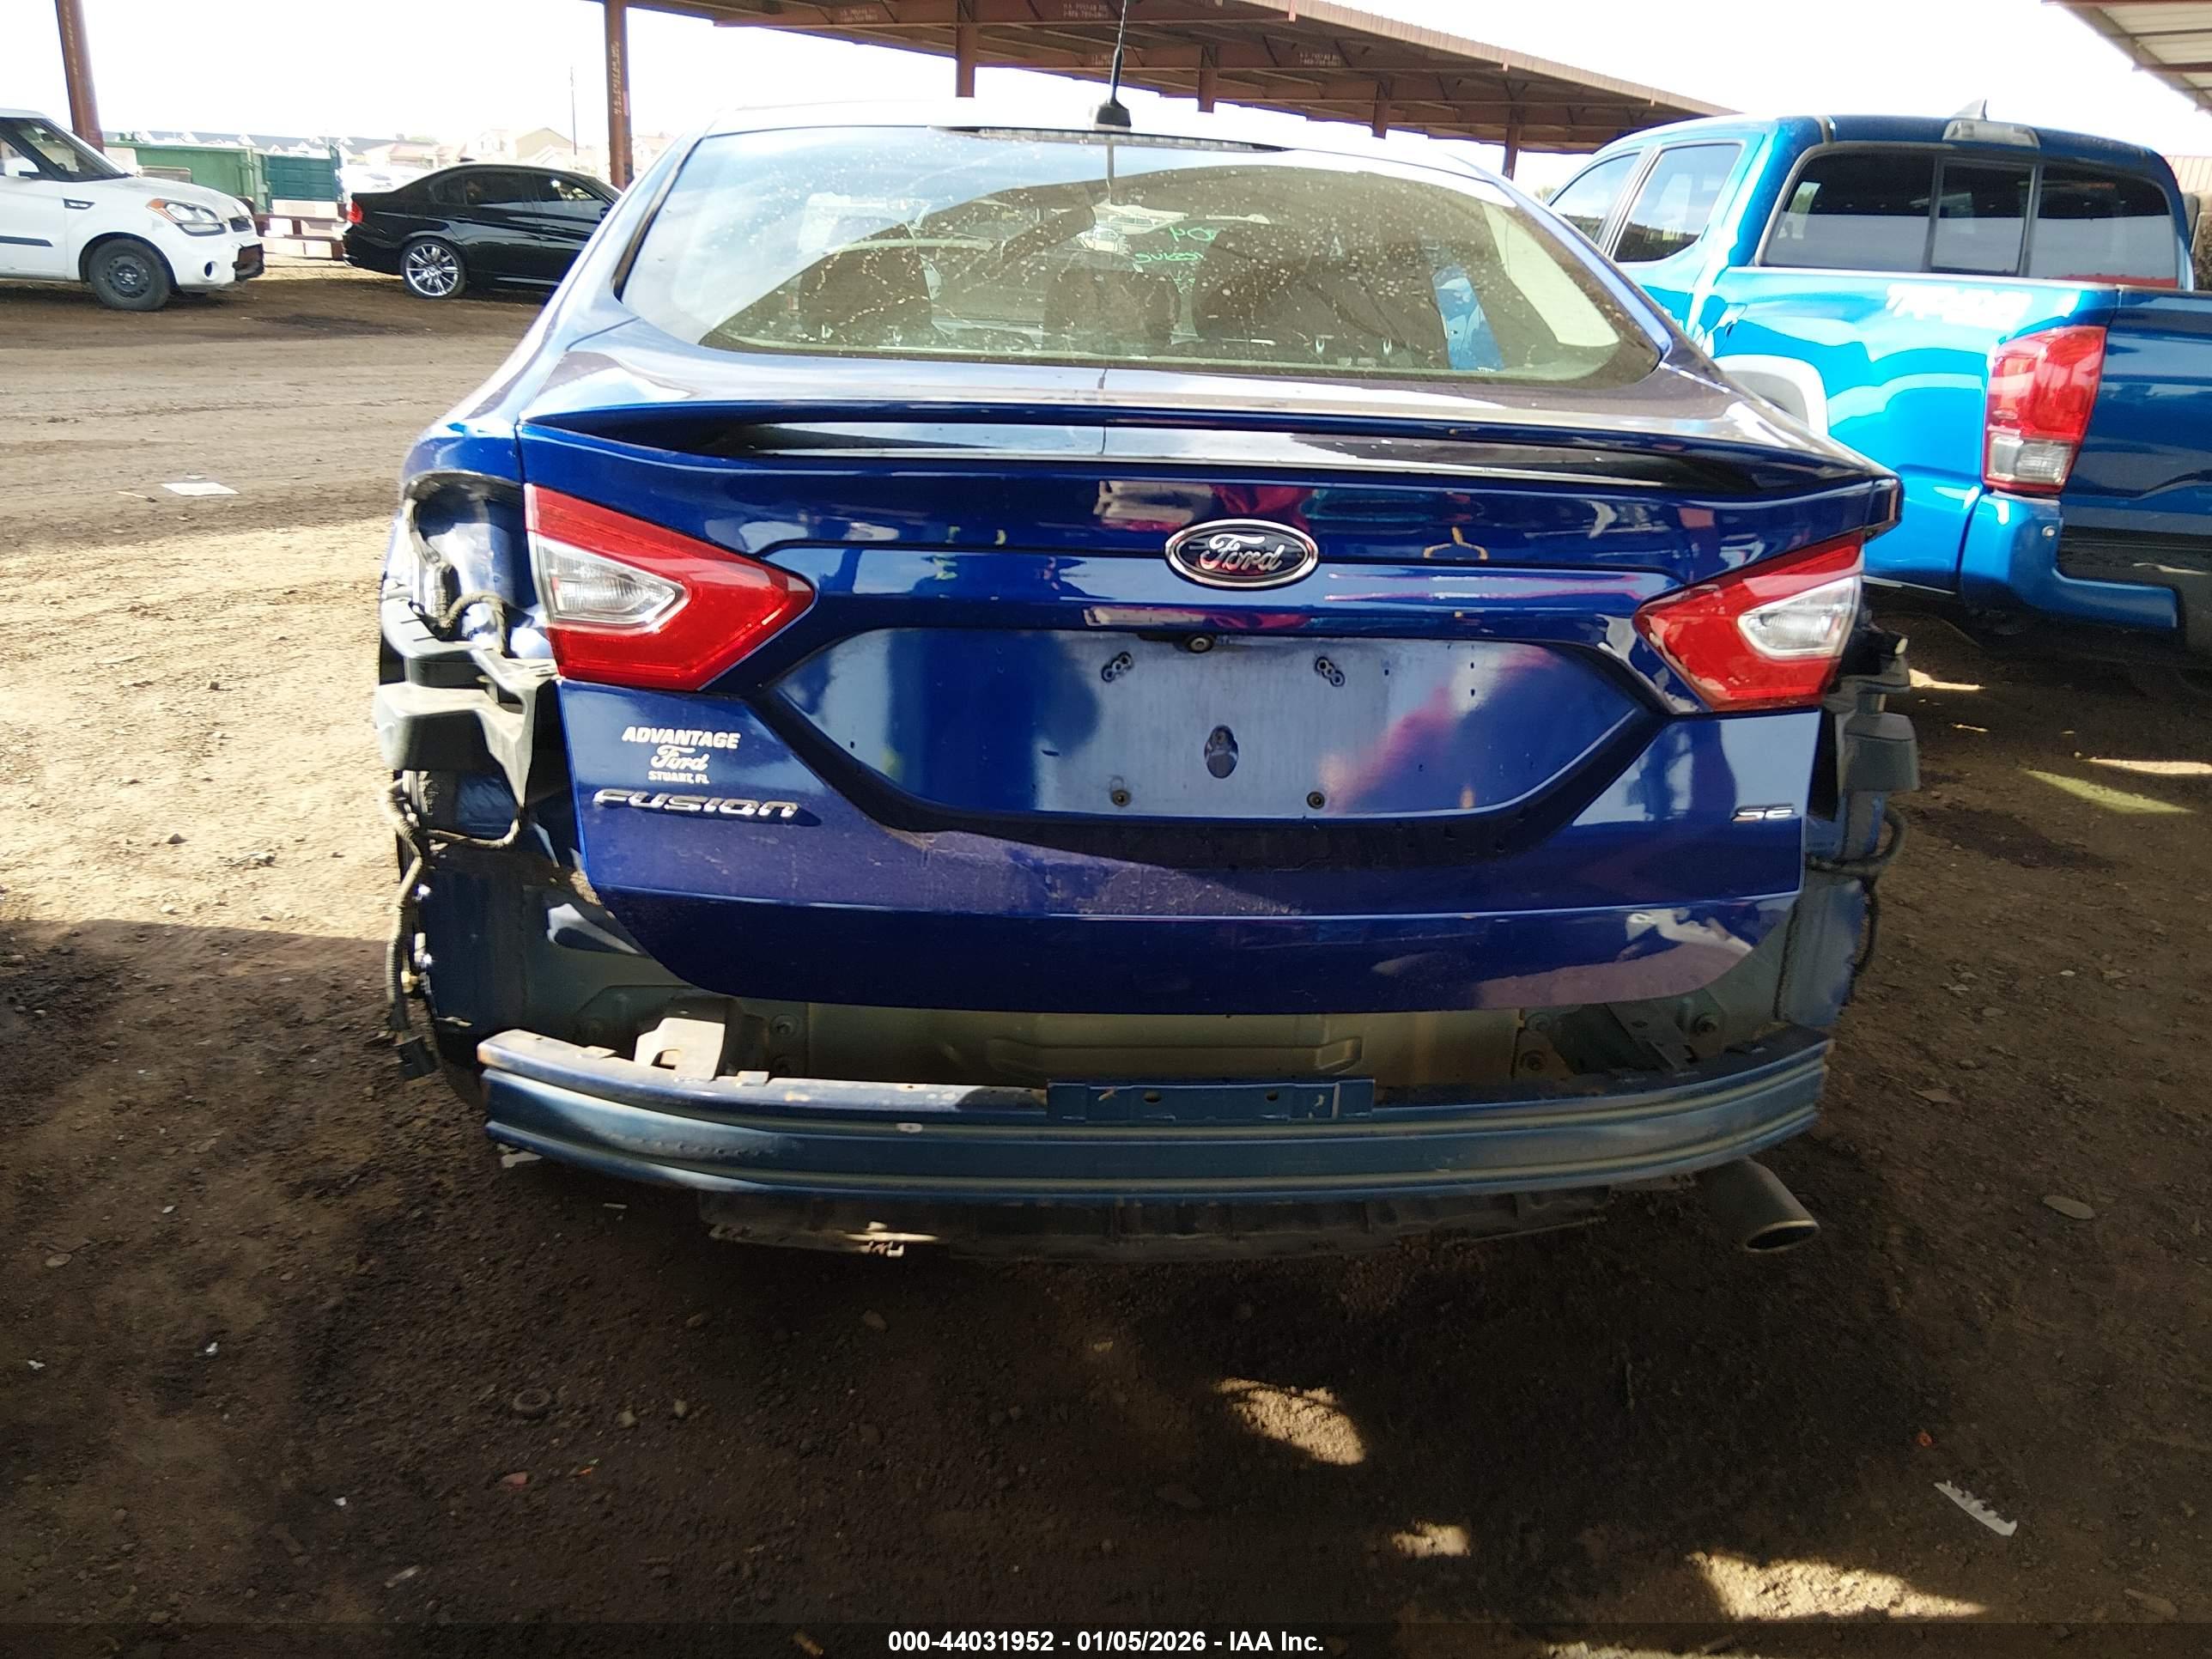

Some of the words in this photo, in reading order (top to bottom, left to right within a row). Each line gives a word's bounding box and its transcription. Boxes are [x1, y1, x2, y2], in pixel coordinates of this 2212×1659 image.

[1200, 533, 1285, 571] Ford
[622, 726, 741, 750] ADVANTAGE
[650, 744, 710, 771] Ford
[592, 788, 799, 818] FUSION
[1732, 805, 1795, 822] SE
